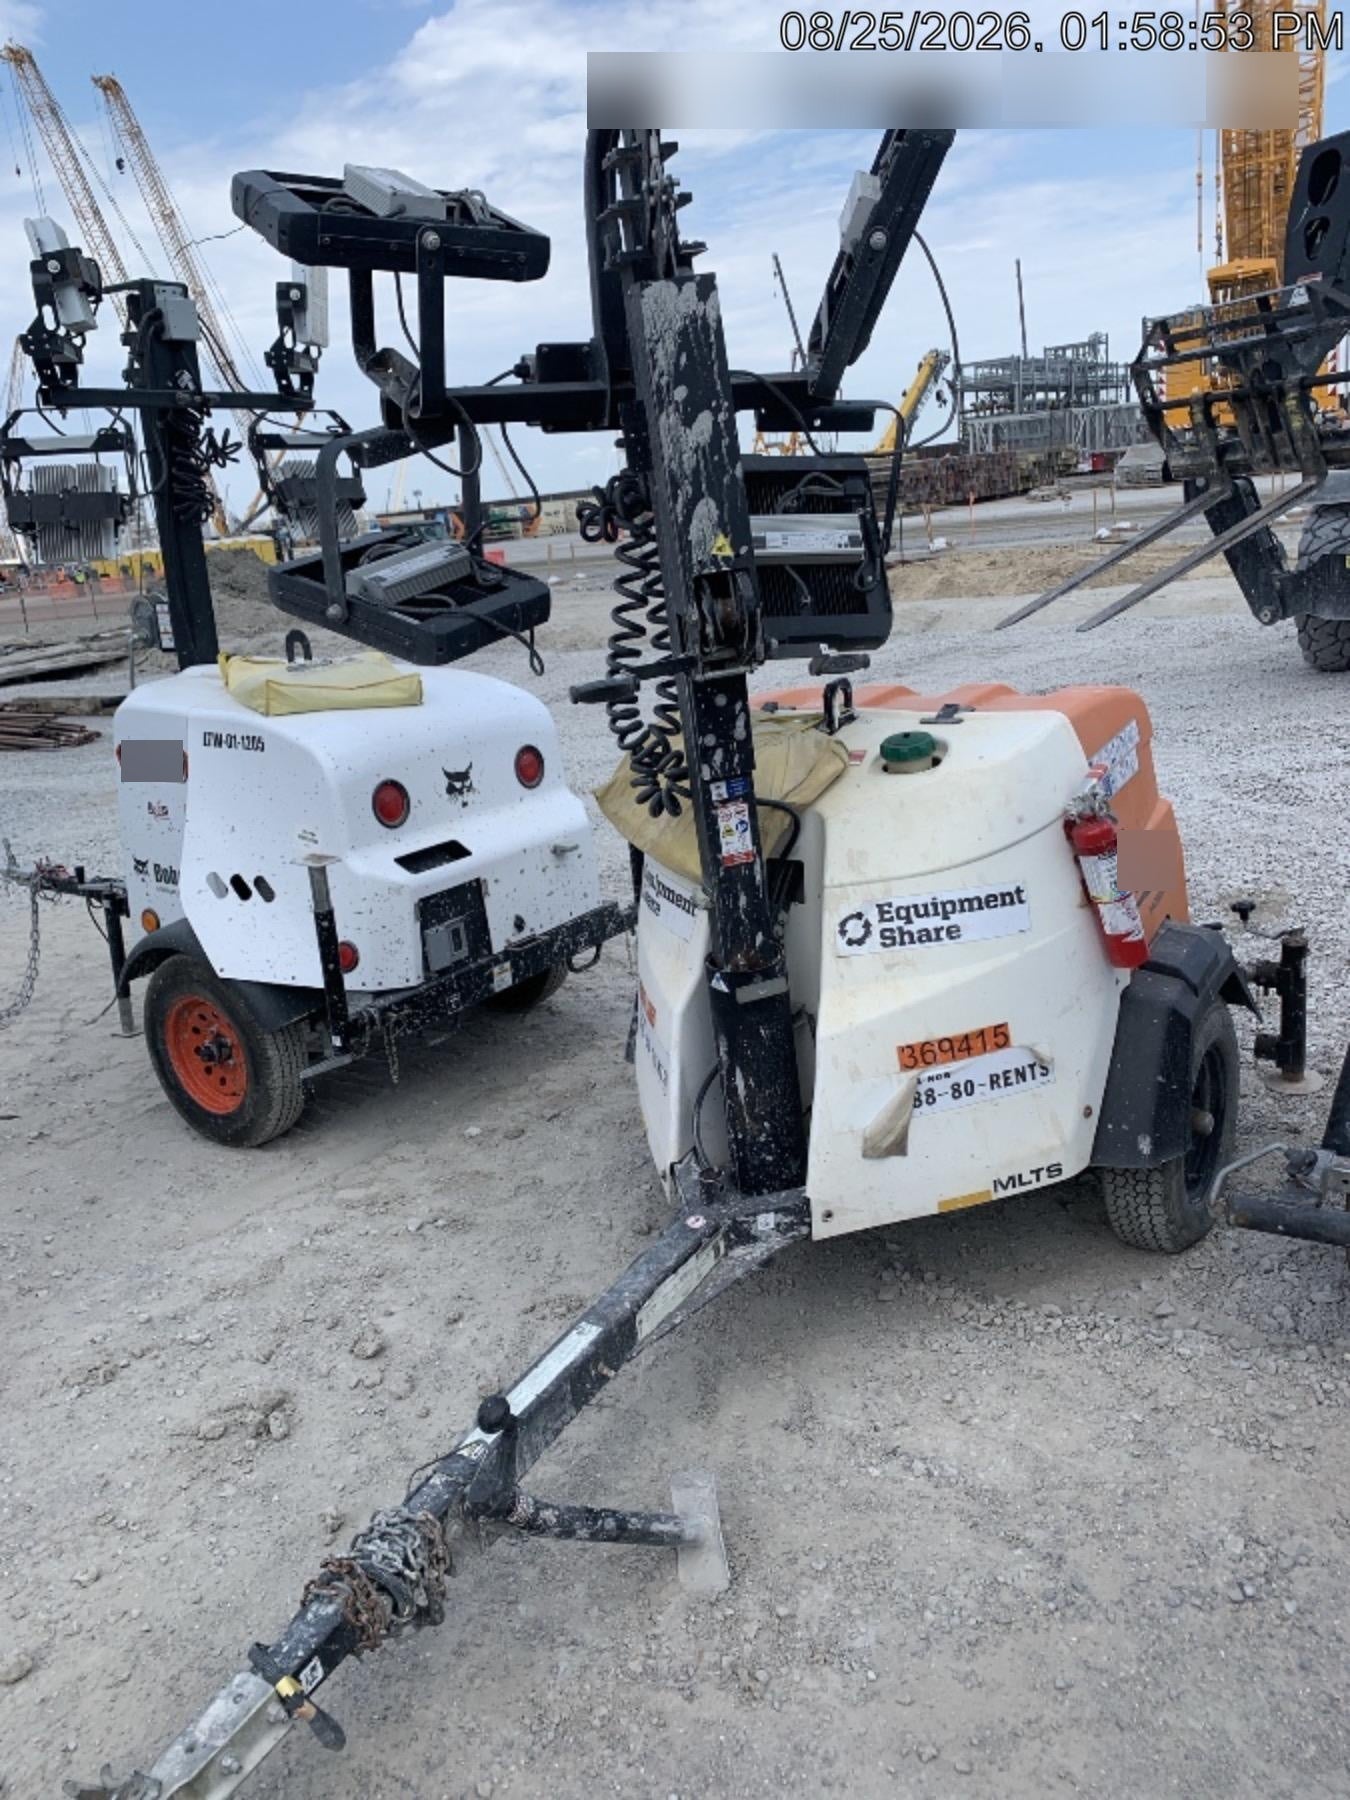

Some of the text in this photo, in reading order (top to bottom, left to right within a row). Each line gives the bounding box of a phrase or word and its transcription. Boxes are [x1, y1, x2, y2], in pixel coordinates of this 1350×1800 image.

[875, 885, 1027, 925] Equipment
[879, 923, 962, 948] Share
[900, 1023, 1010, 1070] 369415
[992, 1162, 1064, 1194] MLTS
